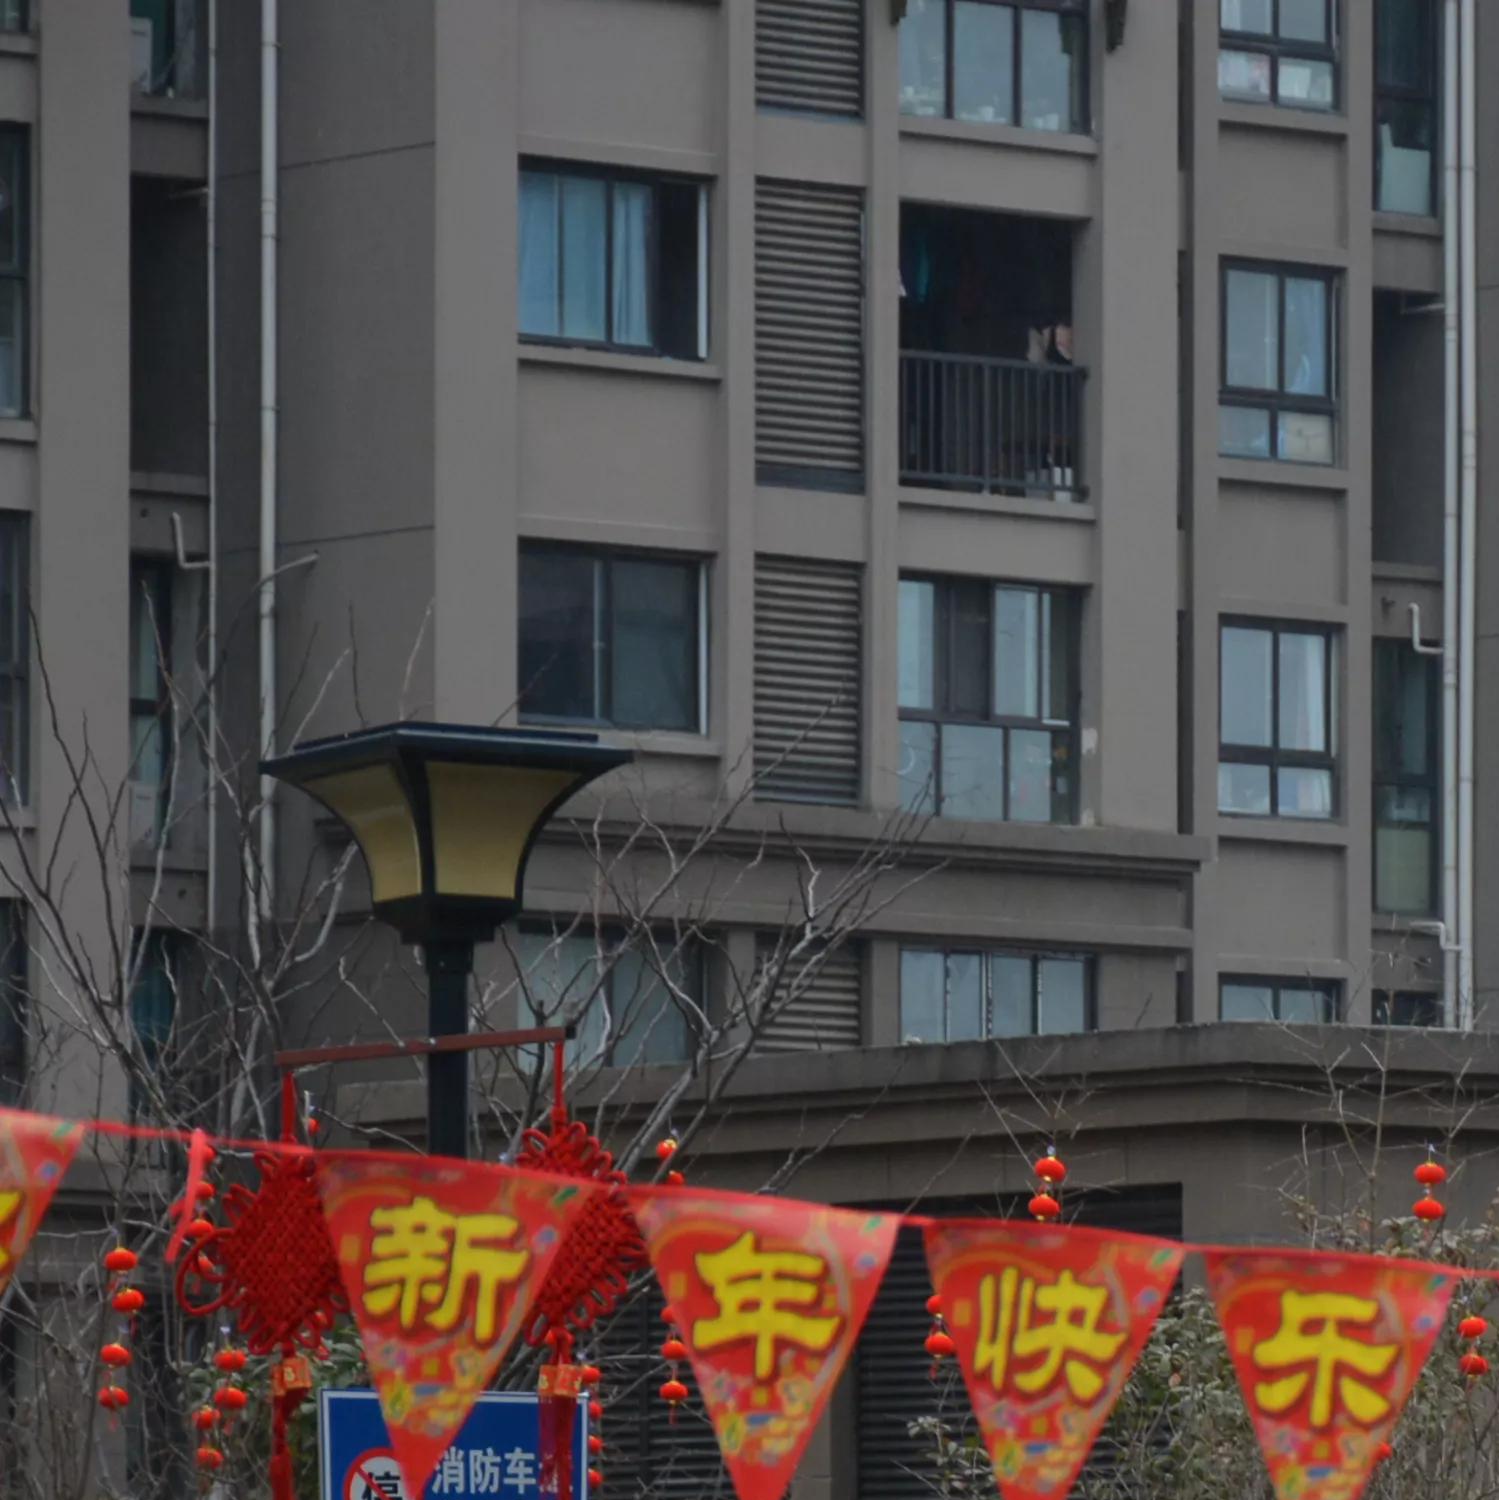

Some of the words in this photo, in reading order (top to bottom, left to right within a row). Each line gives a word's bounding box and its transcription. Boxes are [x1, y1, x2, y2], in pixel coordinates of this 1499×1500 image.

[363, 1197, 527, 1342] 新
[694, 1233, 840, 1378] 年
[974, 1266, 1126, 1399] 快
[1253, 1290, 1398, 1427] 乐
